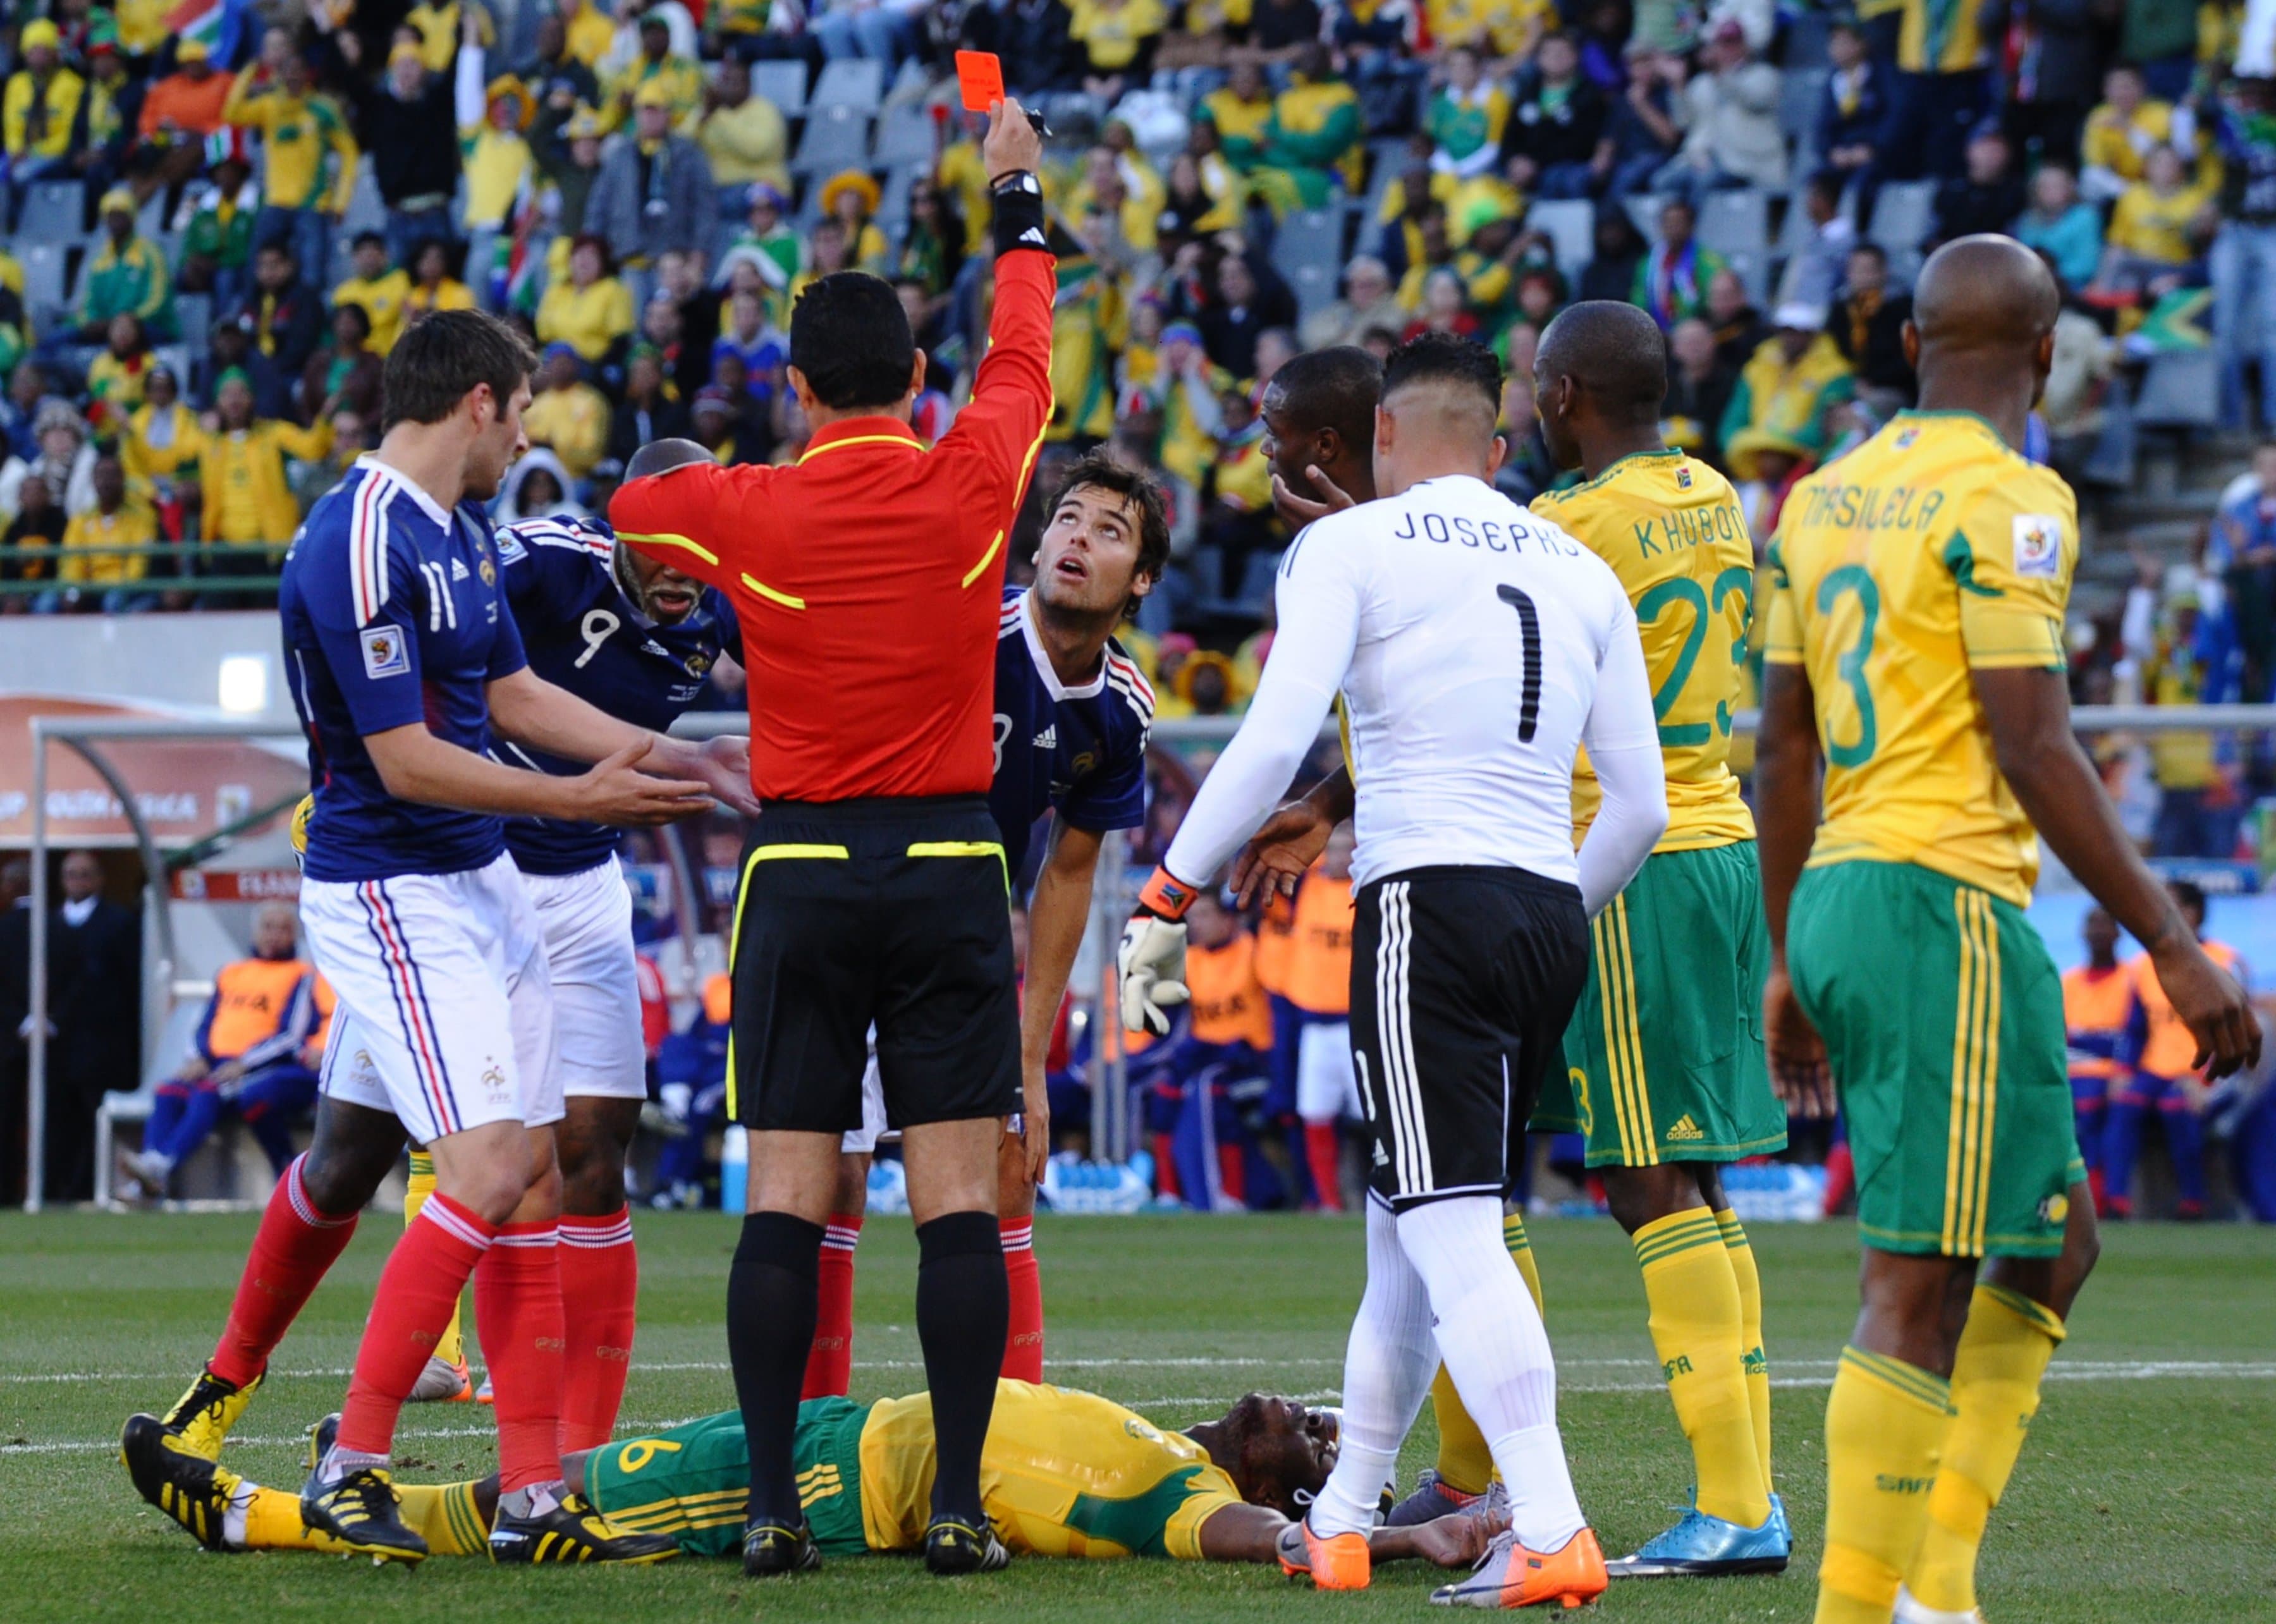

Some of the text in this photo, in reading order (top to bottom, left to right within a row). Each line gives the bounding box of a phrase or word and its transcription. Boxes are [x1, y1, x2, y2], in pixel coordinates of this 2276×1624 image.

[1395, 512, 1579, 557] JOSEPHS
[1802, 485, 1944, 530] MASILELA
[419, 560, 456, 632] 11
[574, 609, 620, 669] 9
[1496, 583, 1541, 743] 1
[1636, 566, 1753, 747] 23
[1817, 564, 1880, 769] 3
[1355, 1049, 1376, 1122] 1
[1666, 1129, 1704, 1140] adidas
